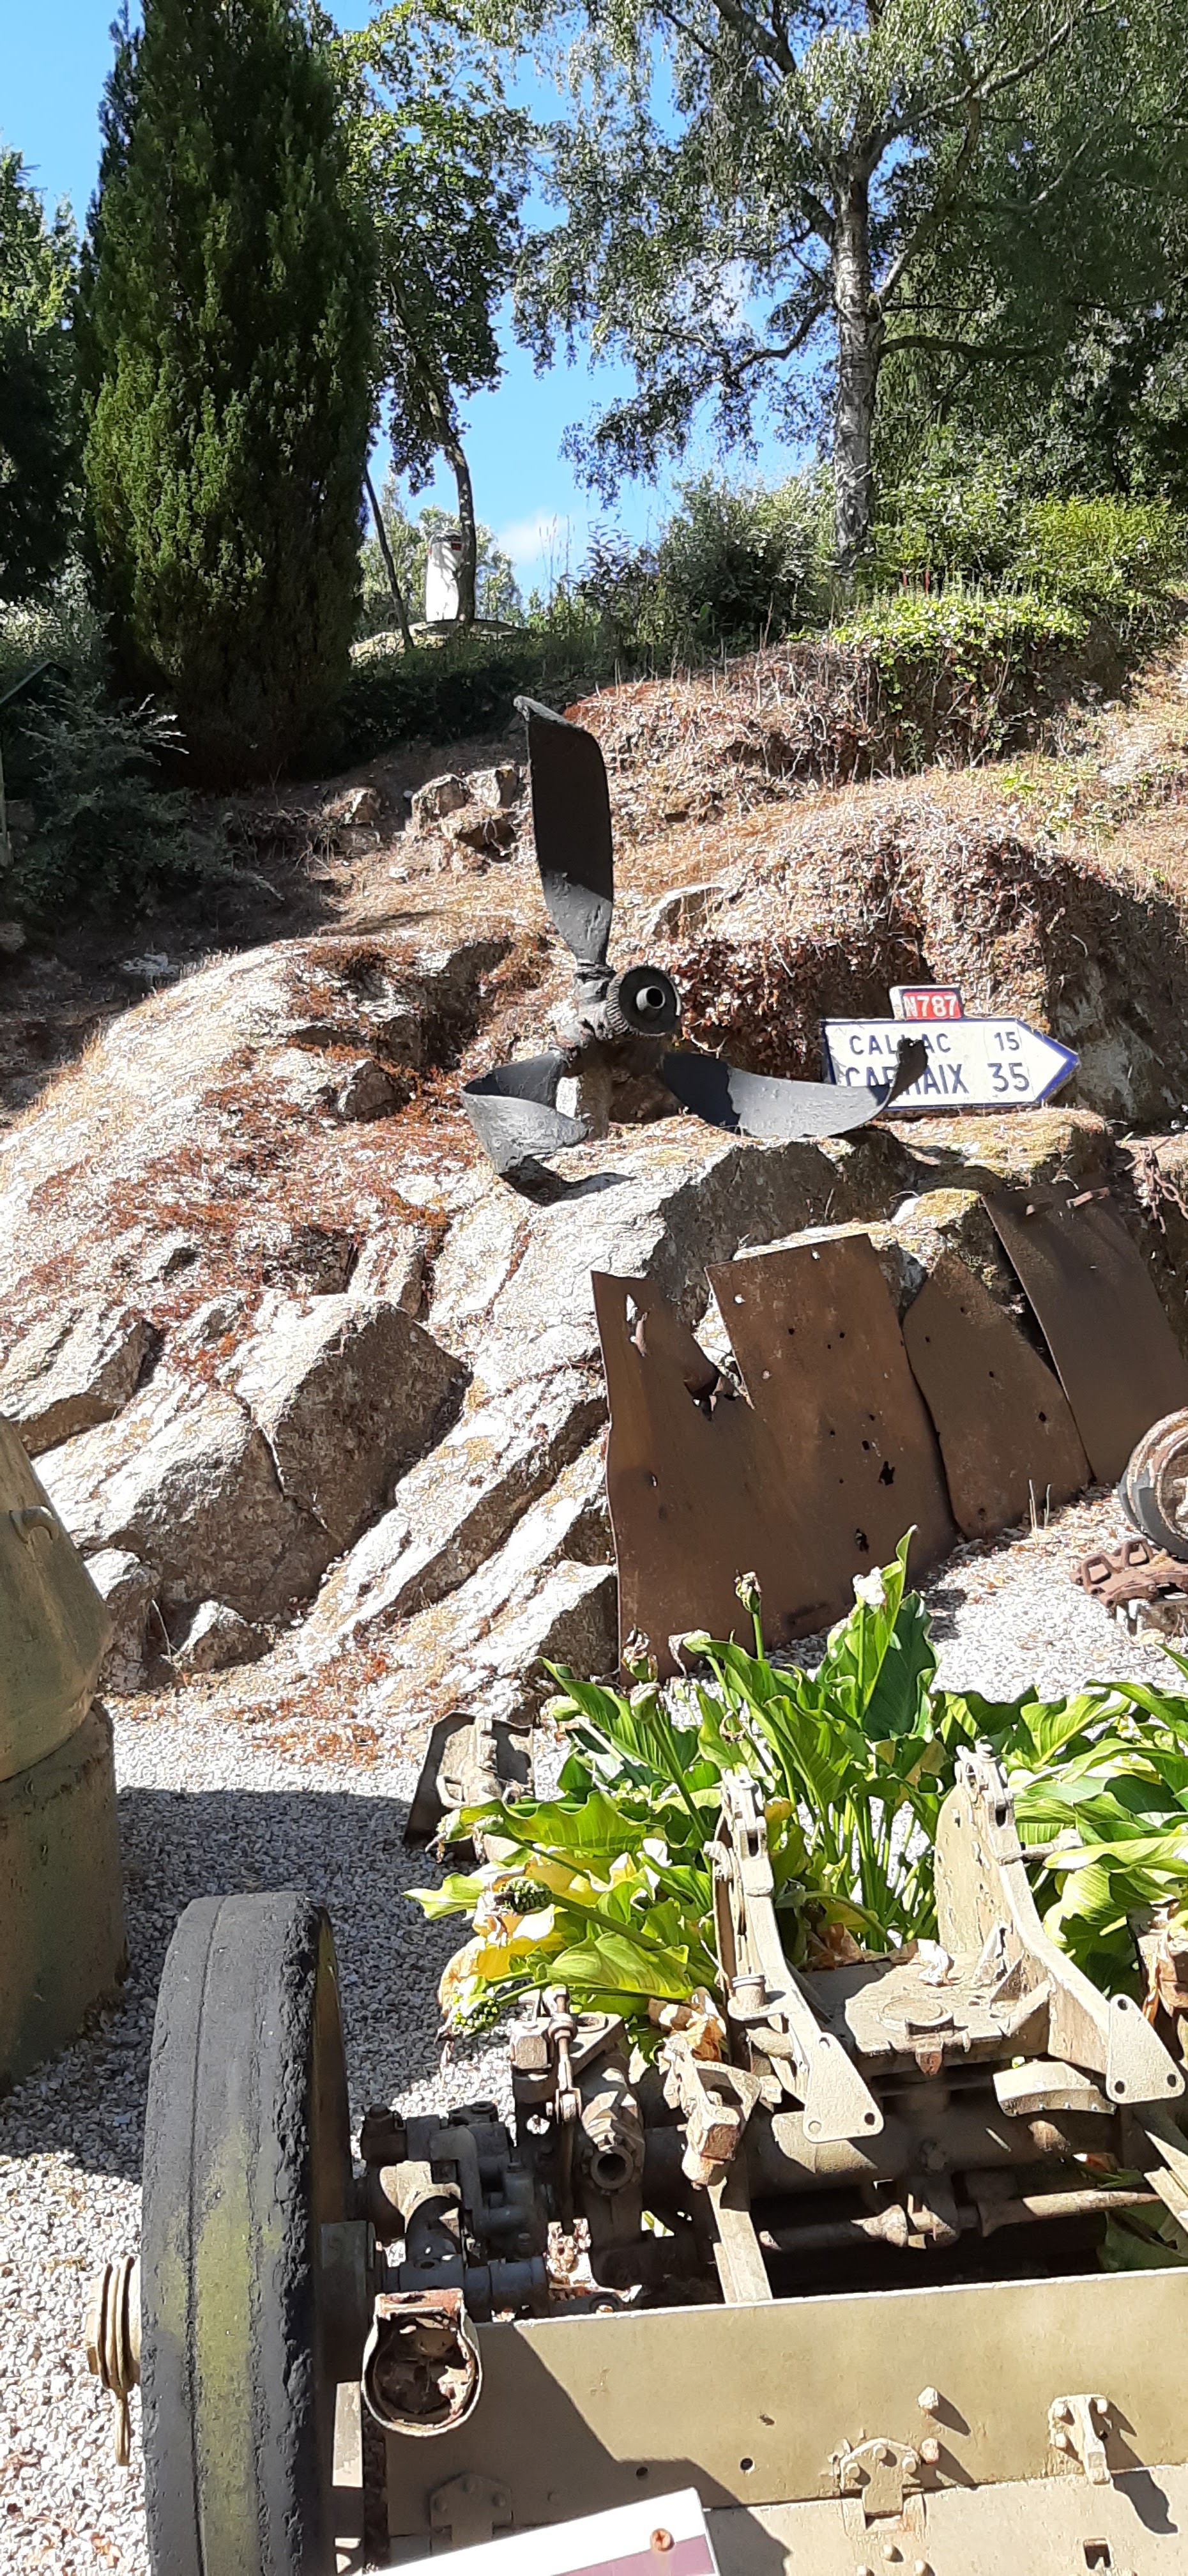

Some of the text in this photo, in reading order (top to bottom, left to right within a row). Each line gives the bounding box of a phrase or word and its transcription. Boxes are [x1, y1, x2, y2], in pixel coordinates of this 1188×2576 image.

[902, 995, 957, 1017] N787
[849, 1031, 1020, 1055] CALAC 15
[987, 1061, 1030, 1092] 35
